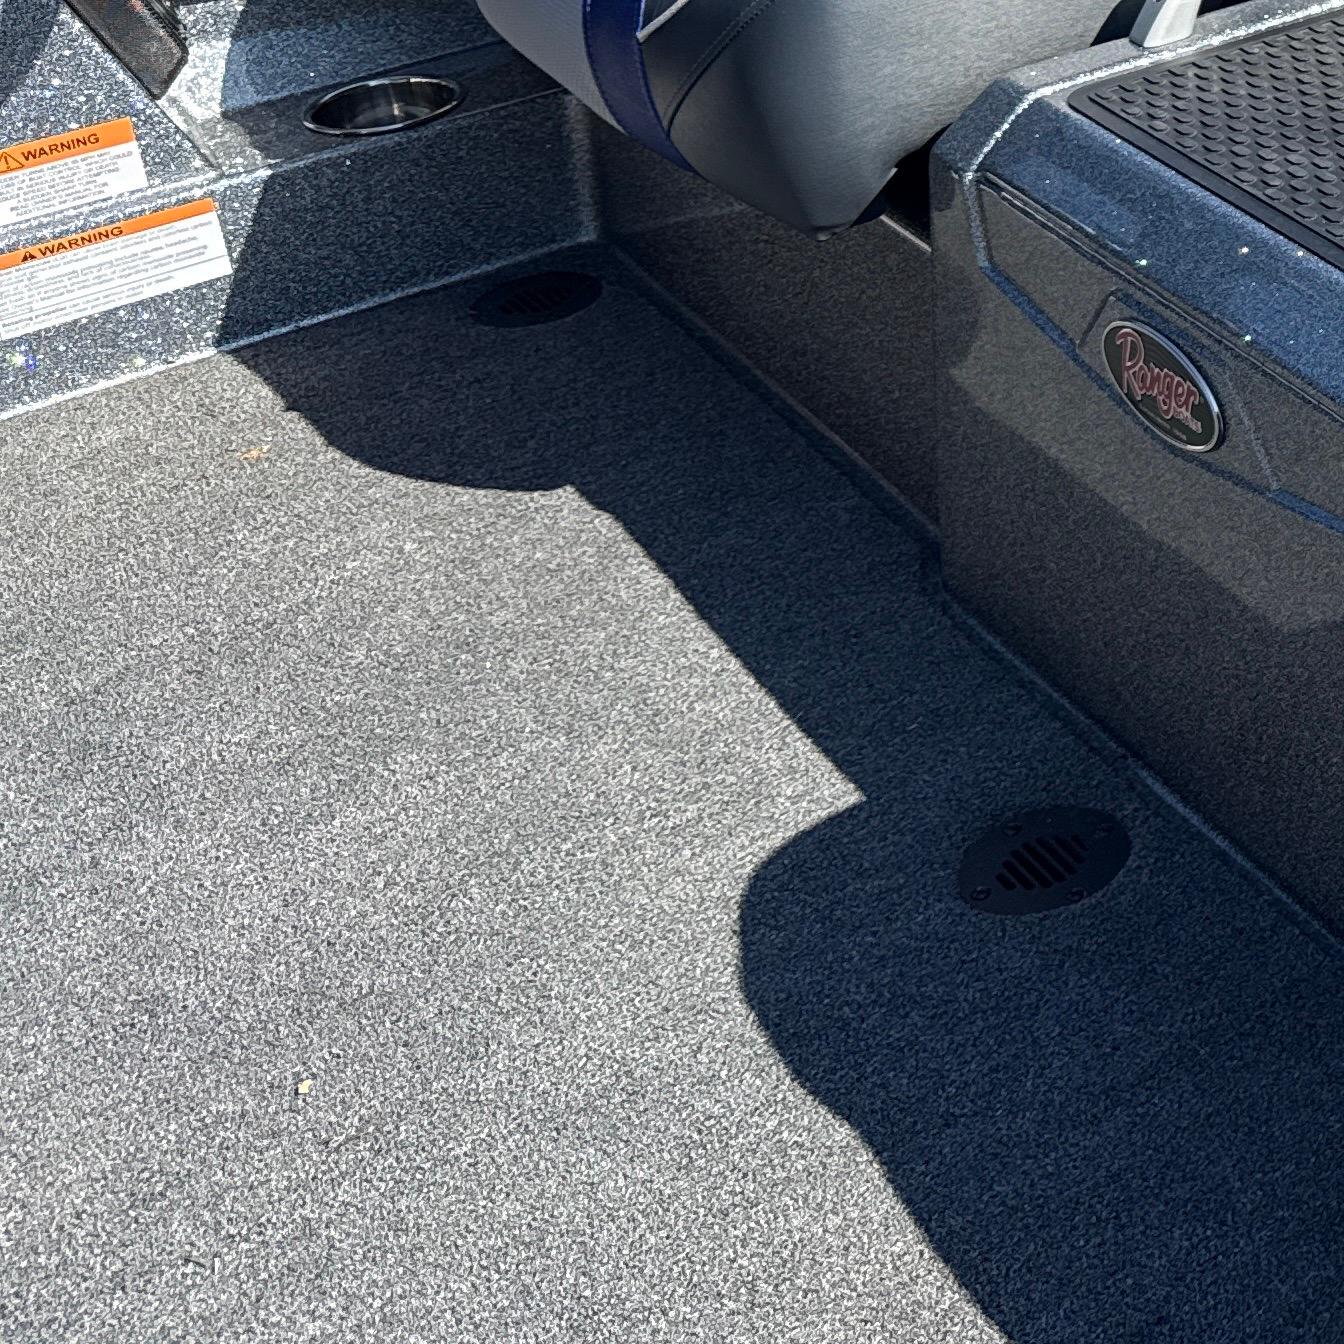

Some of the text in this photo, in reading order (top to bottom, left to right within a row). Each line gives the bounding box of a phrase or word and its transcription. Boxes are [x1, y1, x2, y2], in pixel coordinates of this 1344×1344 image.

[21, 133, 100, 161] WARNING
[37, 225, 124, 257] WARNING
[1116, 328, 1200, 420] Ranger
